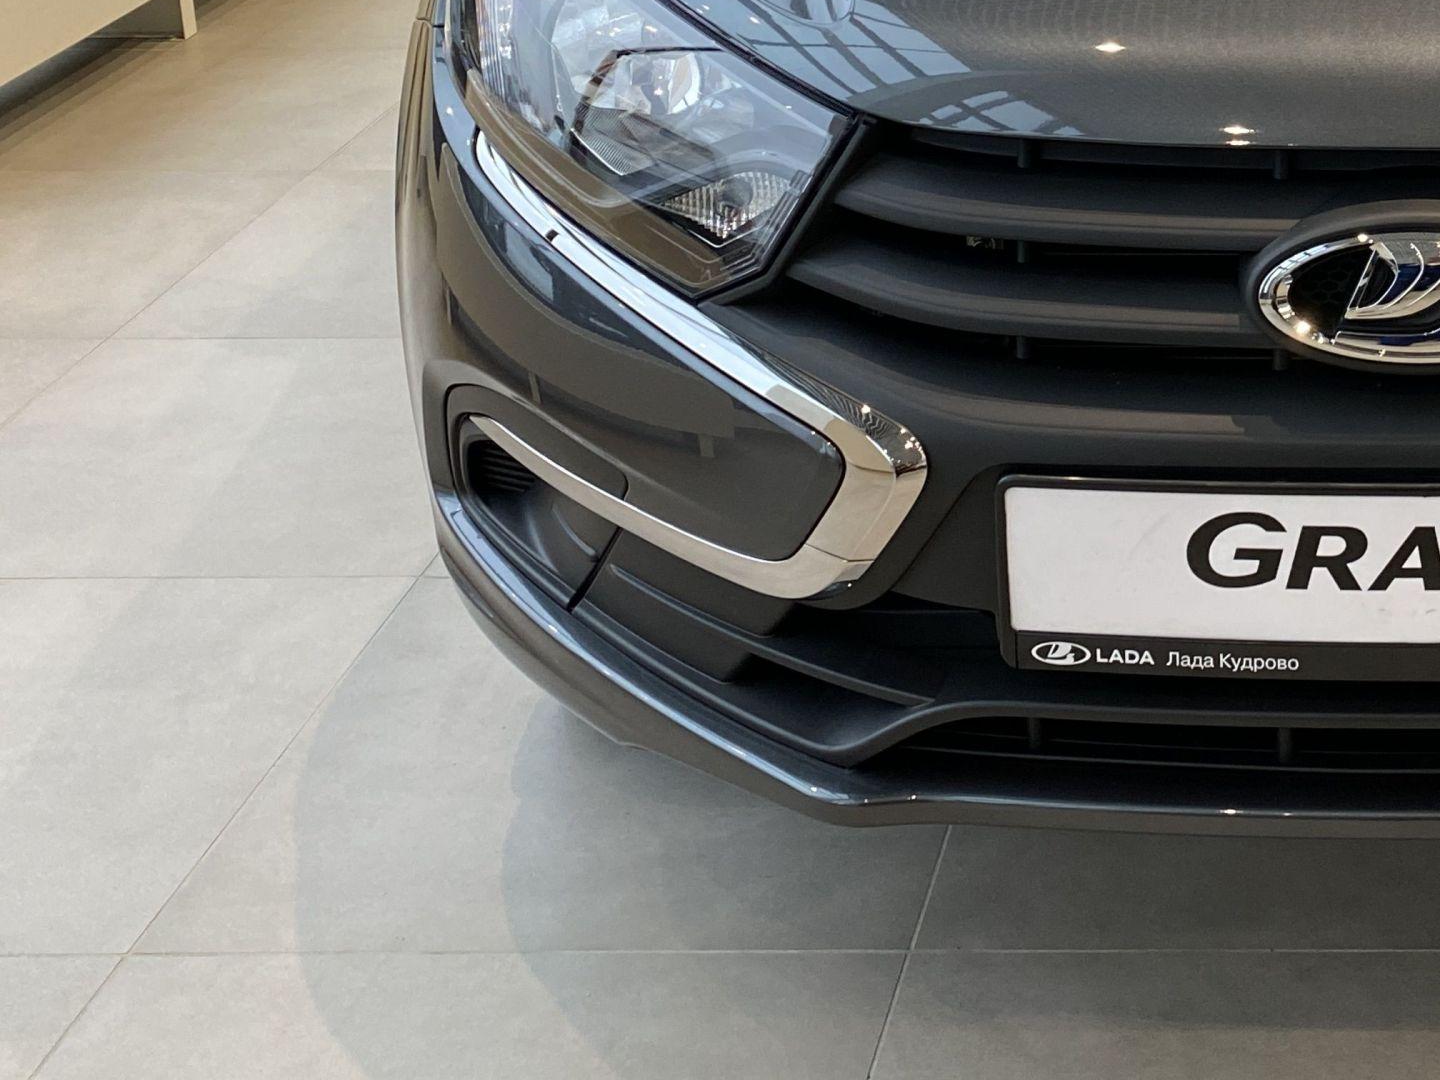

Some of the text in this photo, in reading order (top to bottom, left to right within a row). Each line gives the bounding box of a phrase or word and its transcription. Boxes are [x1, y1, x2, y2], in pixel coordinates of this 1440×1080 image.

[1096, 648, 1155, 665] LADA
[1166, 651, 1300, 672] Лада Кудрово
